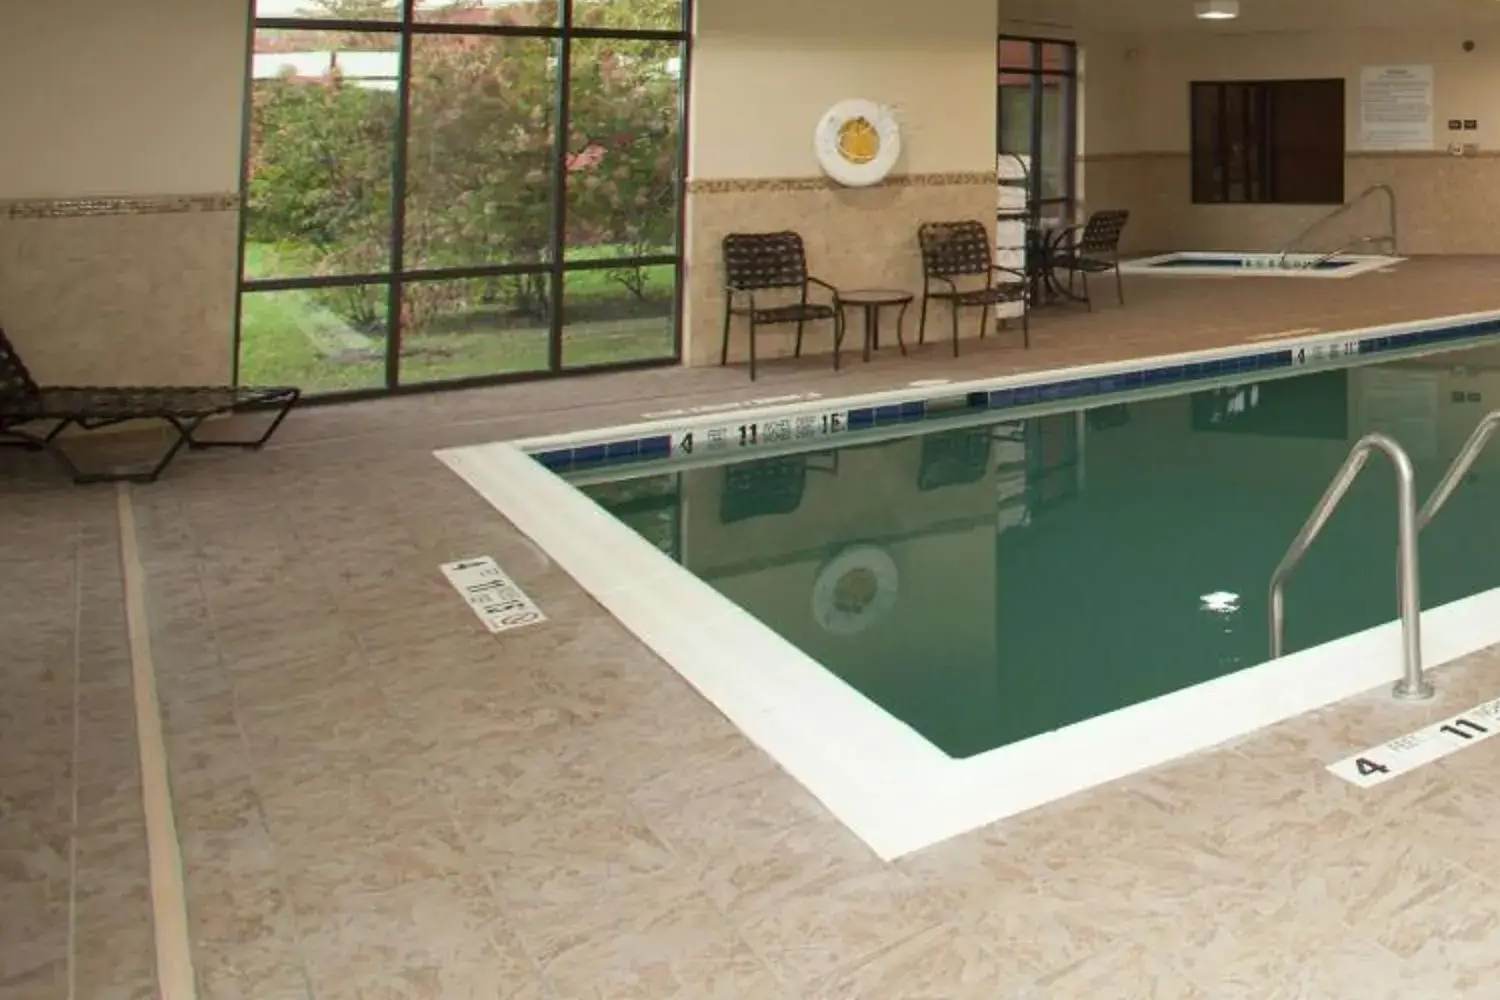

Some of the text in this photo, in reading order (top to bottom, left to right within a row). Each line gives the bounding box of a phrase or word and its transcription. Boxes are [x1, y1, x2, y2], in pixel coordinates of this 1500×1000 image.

[680, 431, 693, 454] 4
[739, 423, 757, 447] 11
[1356, 757, 1390, 776] 4
[1440, 719, 1488, 739] 11
